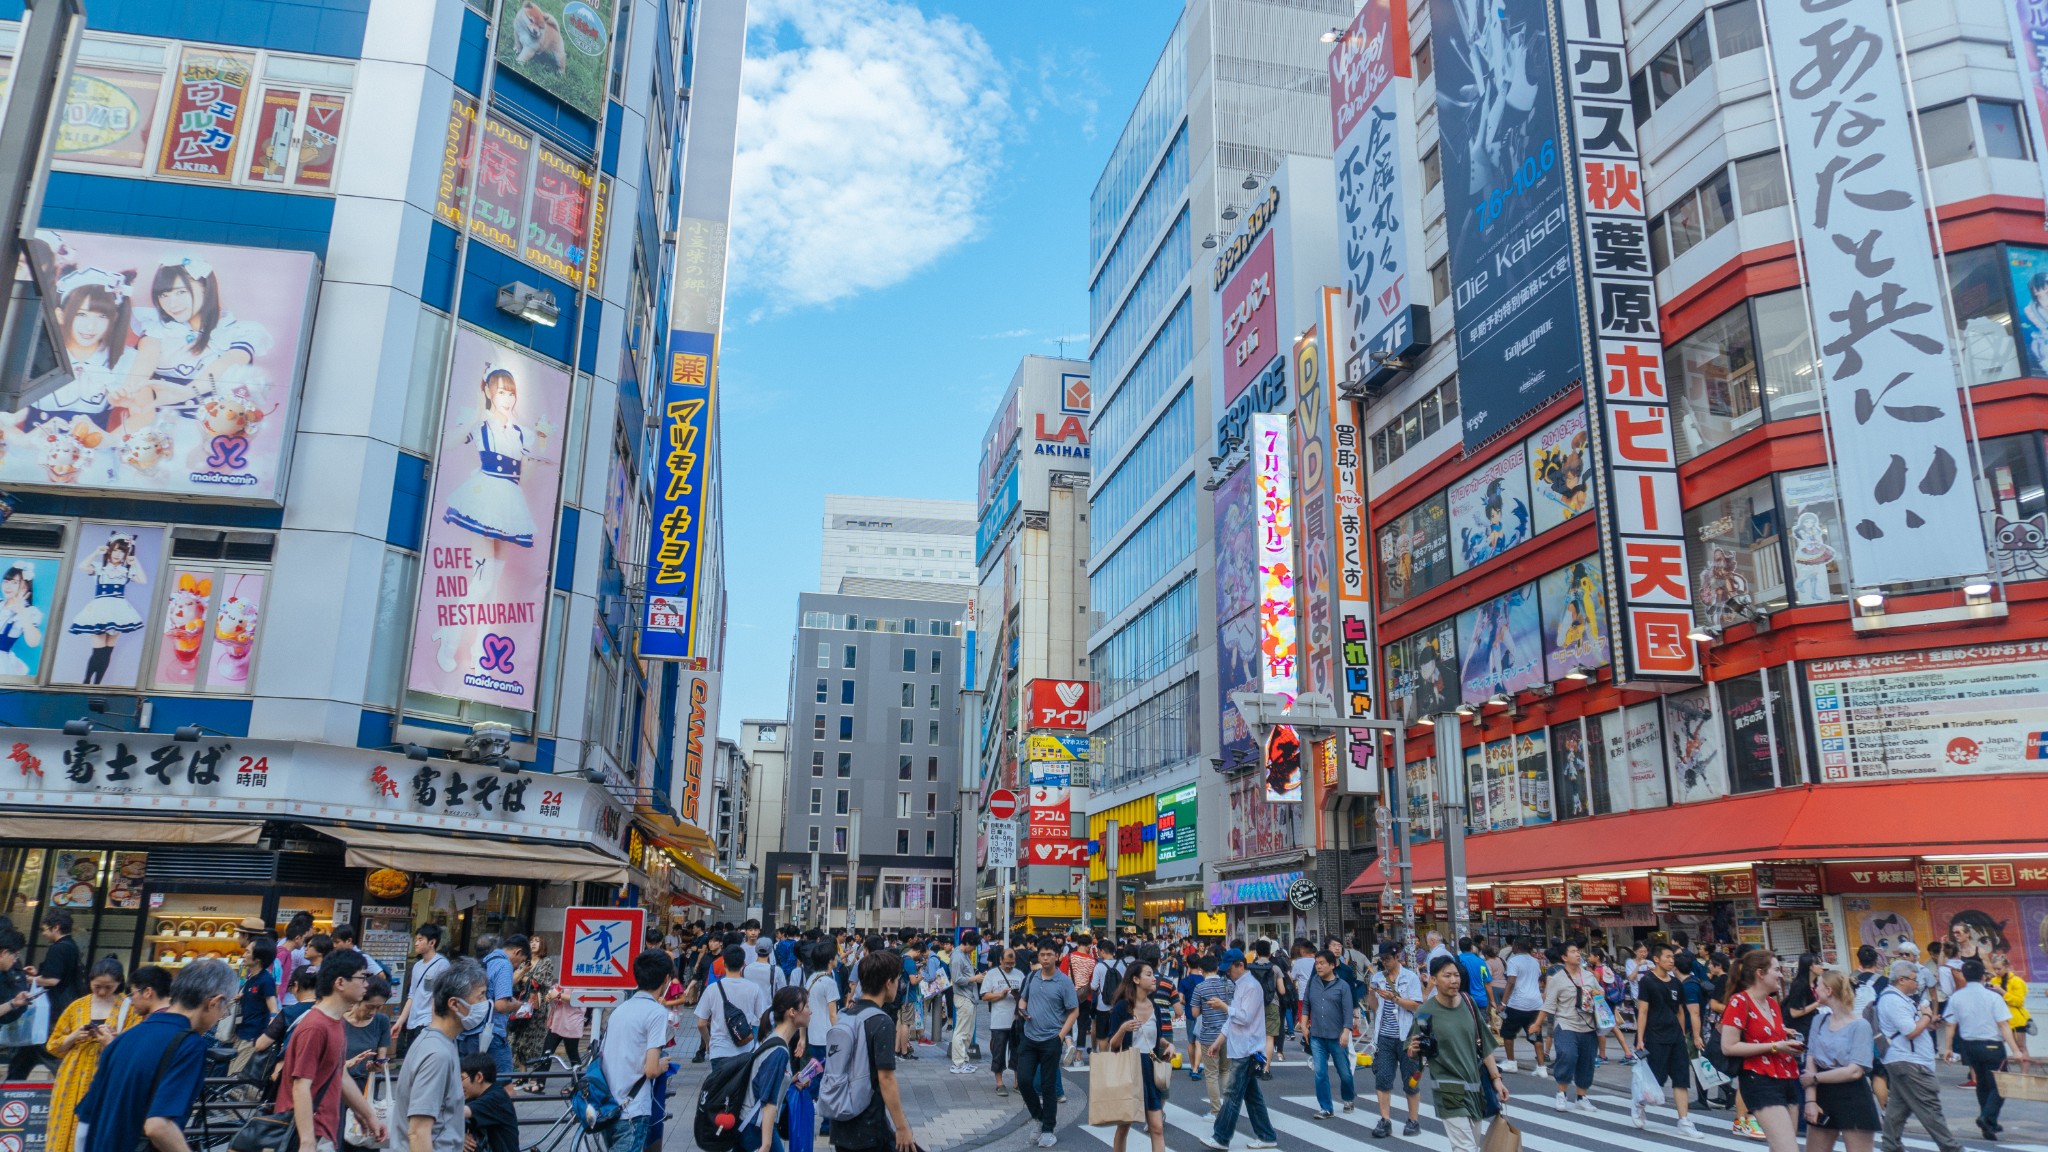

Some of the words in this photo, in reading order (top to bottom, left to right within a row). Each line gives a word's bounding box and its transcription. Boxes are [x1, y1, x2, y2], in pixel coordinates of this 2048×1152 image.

[172, 161, 219, 174] AKIBA
[1790, 0, 1957, 541] あなたと共に!!
[1457, 269, 1488, 311] Die
[1224, 272, 1271, 347] エスパス
[674, 355, 705, 385] 薬
[1217, 355, 1286, 458] ESPACE
[1036, 413, 1090, 444] LA
[190, 471, 257, 486] maidreamin
[433, 547, 473, 569] CAFE
[436, 575, 468, 598] AND
[437, 602, 535, 627] RESTAURANT
[653, 612, 684, 628] 免税
[464, 673, 524, 695] maidreamin
[1815, 684, 1834, 695] 6F
[1850, 686, 1881, 694] Trading
[1882, 682, 1907, 690] Cards
[1930, 679, 1947, 687] buy
[1948, 677, 1967, 686] your
[1970, 675, 1991, 683] used
[1816, 698, 1838, 707] 5F
[1852, 699, 1877, 707] Robot
[1878, 697, 1894, 705] and
[1895, 696, 1922, 704] Action
[1924, 693, 1956, 702] Figures
[1966, 690, 1989, 698] Tools
[1999, 686, 2040, 696] Materials
[1819, 711, 1839, 722] 4F
[1854, 712, 1897, 721] Character
[1897, 709, 1929, 718] Figures
[1820, 725, 1841, 737] 3F
[1856, 725, 1907, 735] Secondhand
[1908, 722, 1941, 732] Figures
[1949, 720, 1984, 729] Trading
[1984, 718, 2019, 727] Figures
[1061, 738, 1090, 746] スマホスピタ
[1822, 739, 1844, 751] 2F
[1858, 741, 1901, 749] Character
[1901, 739, 1929, 747] Goods
[682, 677, 708, 825] GAMERS
[1904, 752, 1932, 760] Goods
[62, 739, 232, 786] 富士そば
[239, 755, 269, 773] 24
[1826, 754, 1844, 764] 1F
[1828, 767, 1845, 779] B1
[1891, 767, 1937, 775] Showcases
[236, 773, 268, 788] 時間
[411, 766, 532, 812] 富士そば
[541, 790, 563, 806] 24
[539, 804, 561, 818] 時間
[1034, 810, 1065, 822] アコム
[1031, 828, 1044, 837] 3F
[1045, 828, 1061, 837] 入口
[1054, 845, 1089, 860] アイフ
[1877, 870, 1916, 883] 秋葉原
[1961, 864, 2016, 886] 天国
[1696, 891, 1709, 899] 4F
[1805, 884, 1819, 894] 3F
[1469, 903, 1480, 911] 6F
[1532, 899, 1543, 907] 5F
[1607, 896, 1619, 904] 4F
[1414, 905, 1424, 914] 7F
[575, 963, 613, 975] 横断禁止
